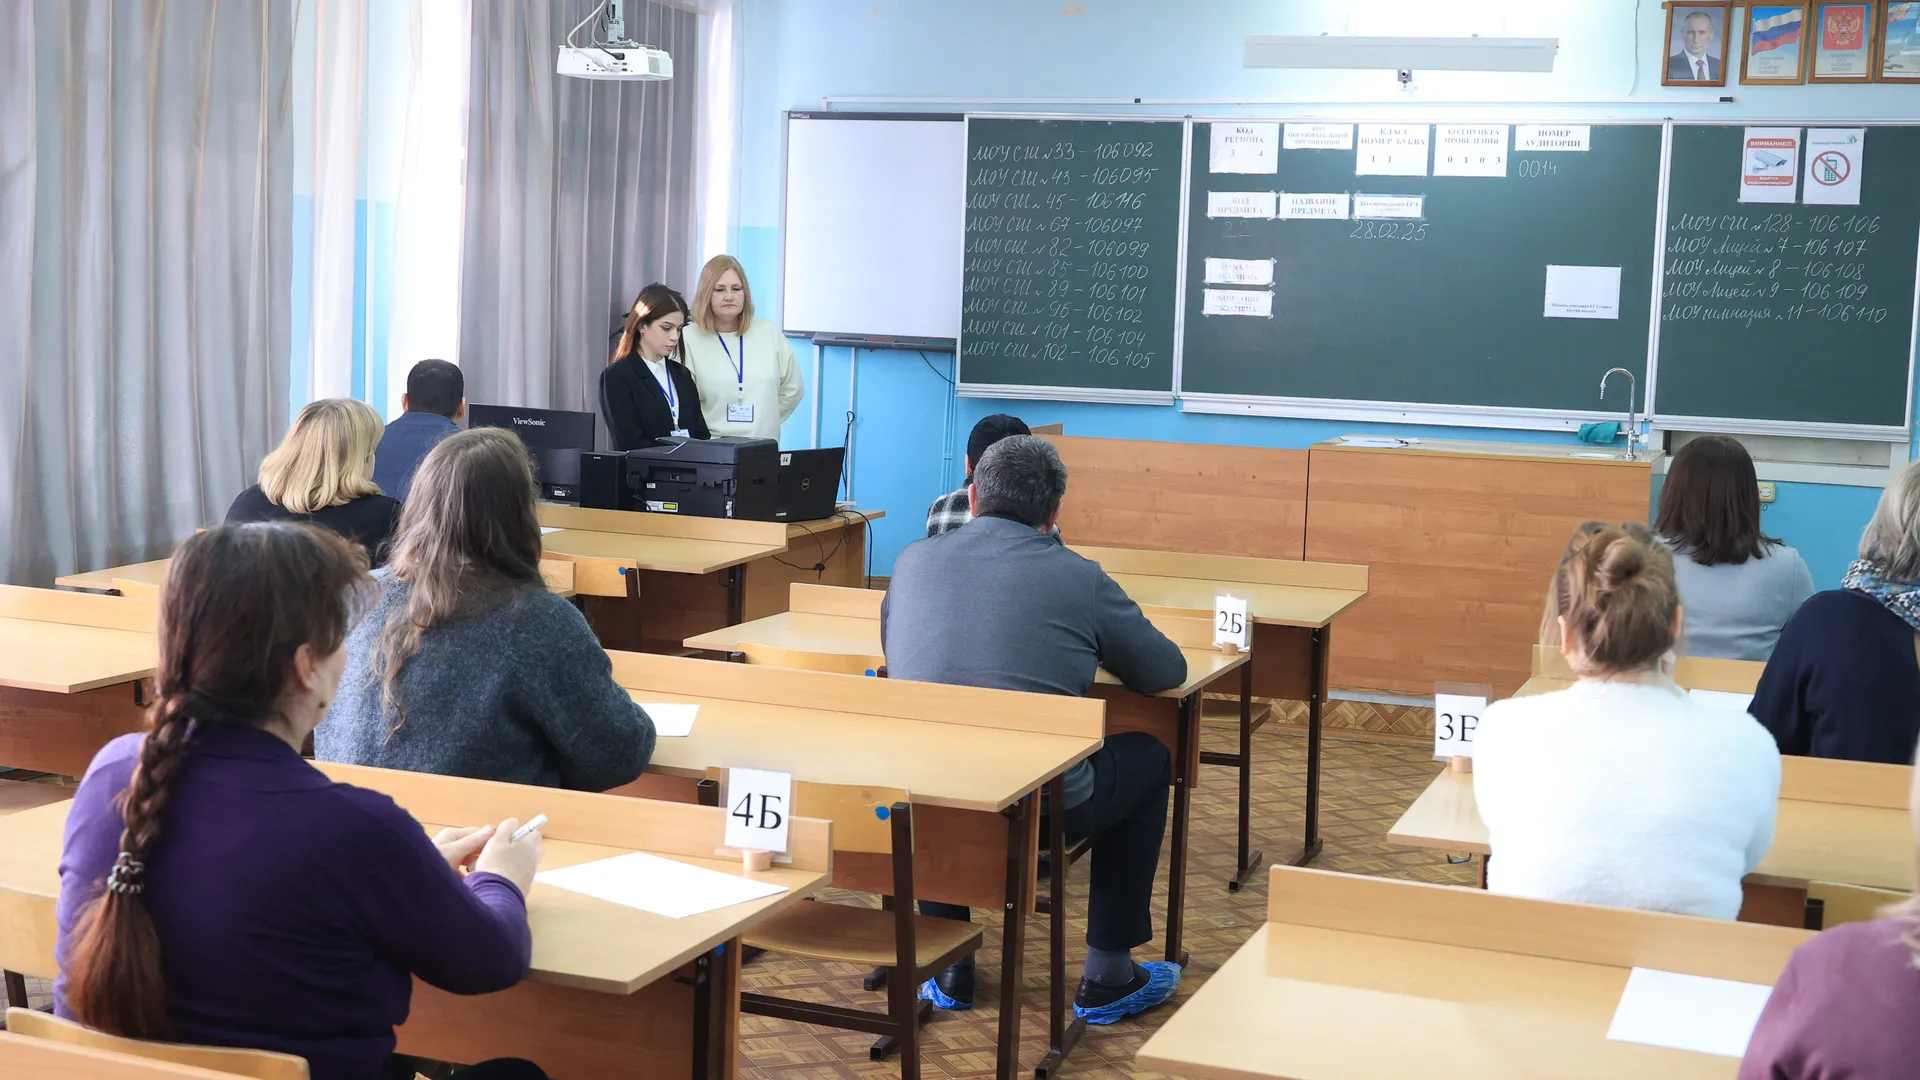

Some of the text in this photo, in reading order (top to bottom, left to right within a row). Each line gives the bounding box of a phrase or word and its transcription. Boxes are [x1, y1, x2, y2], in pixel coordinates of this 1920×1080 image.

[1518, 159, 1557, 178] 0014
[1349, 220, 1430, 241] 28.02.25
[512, 417, 546, 426] ViewSonic
[1218, 610, 1243, 634] 2Б
[732, 792, 782, 829] 4Б
